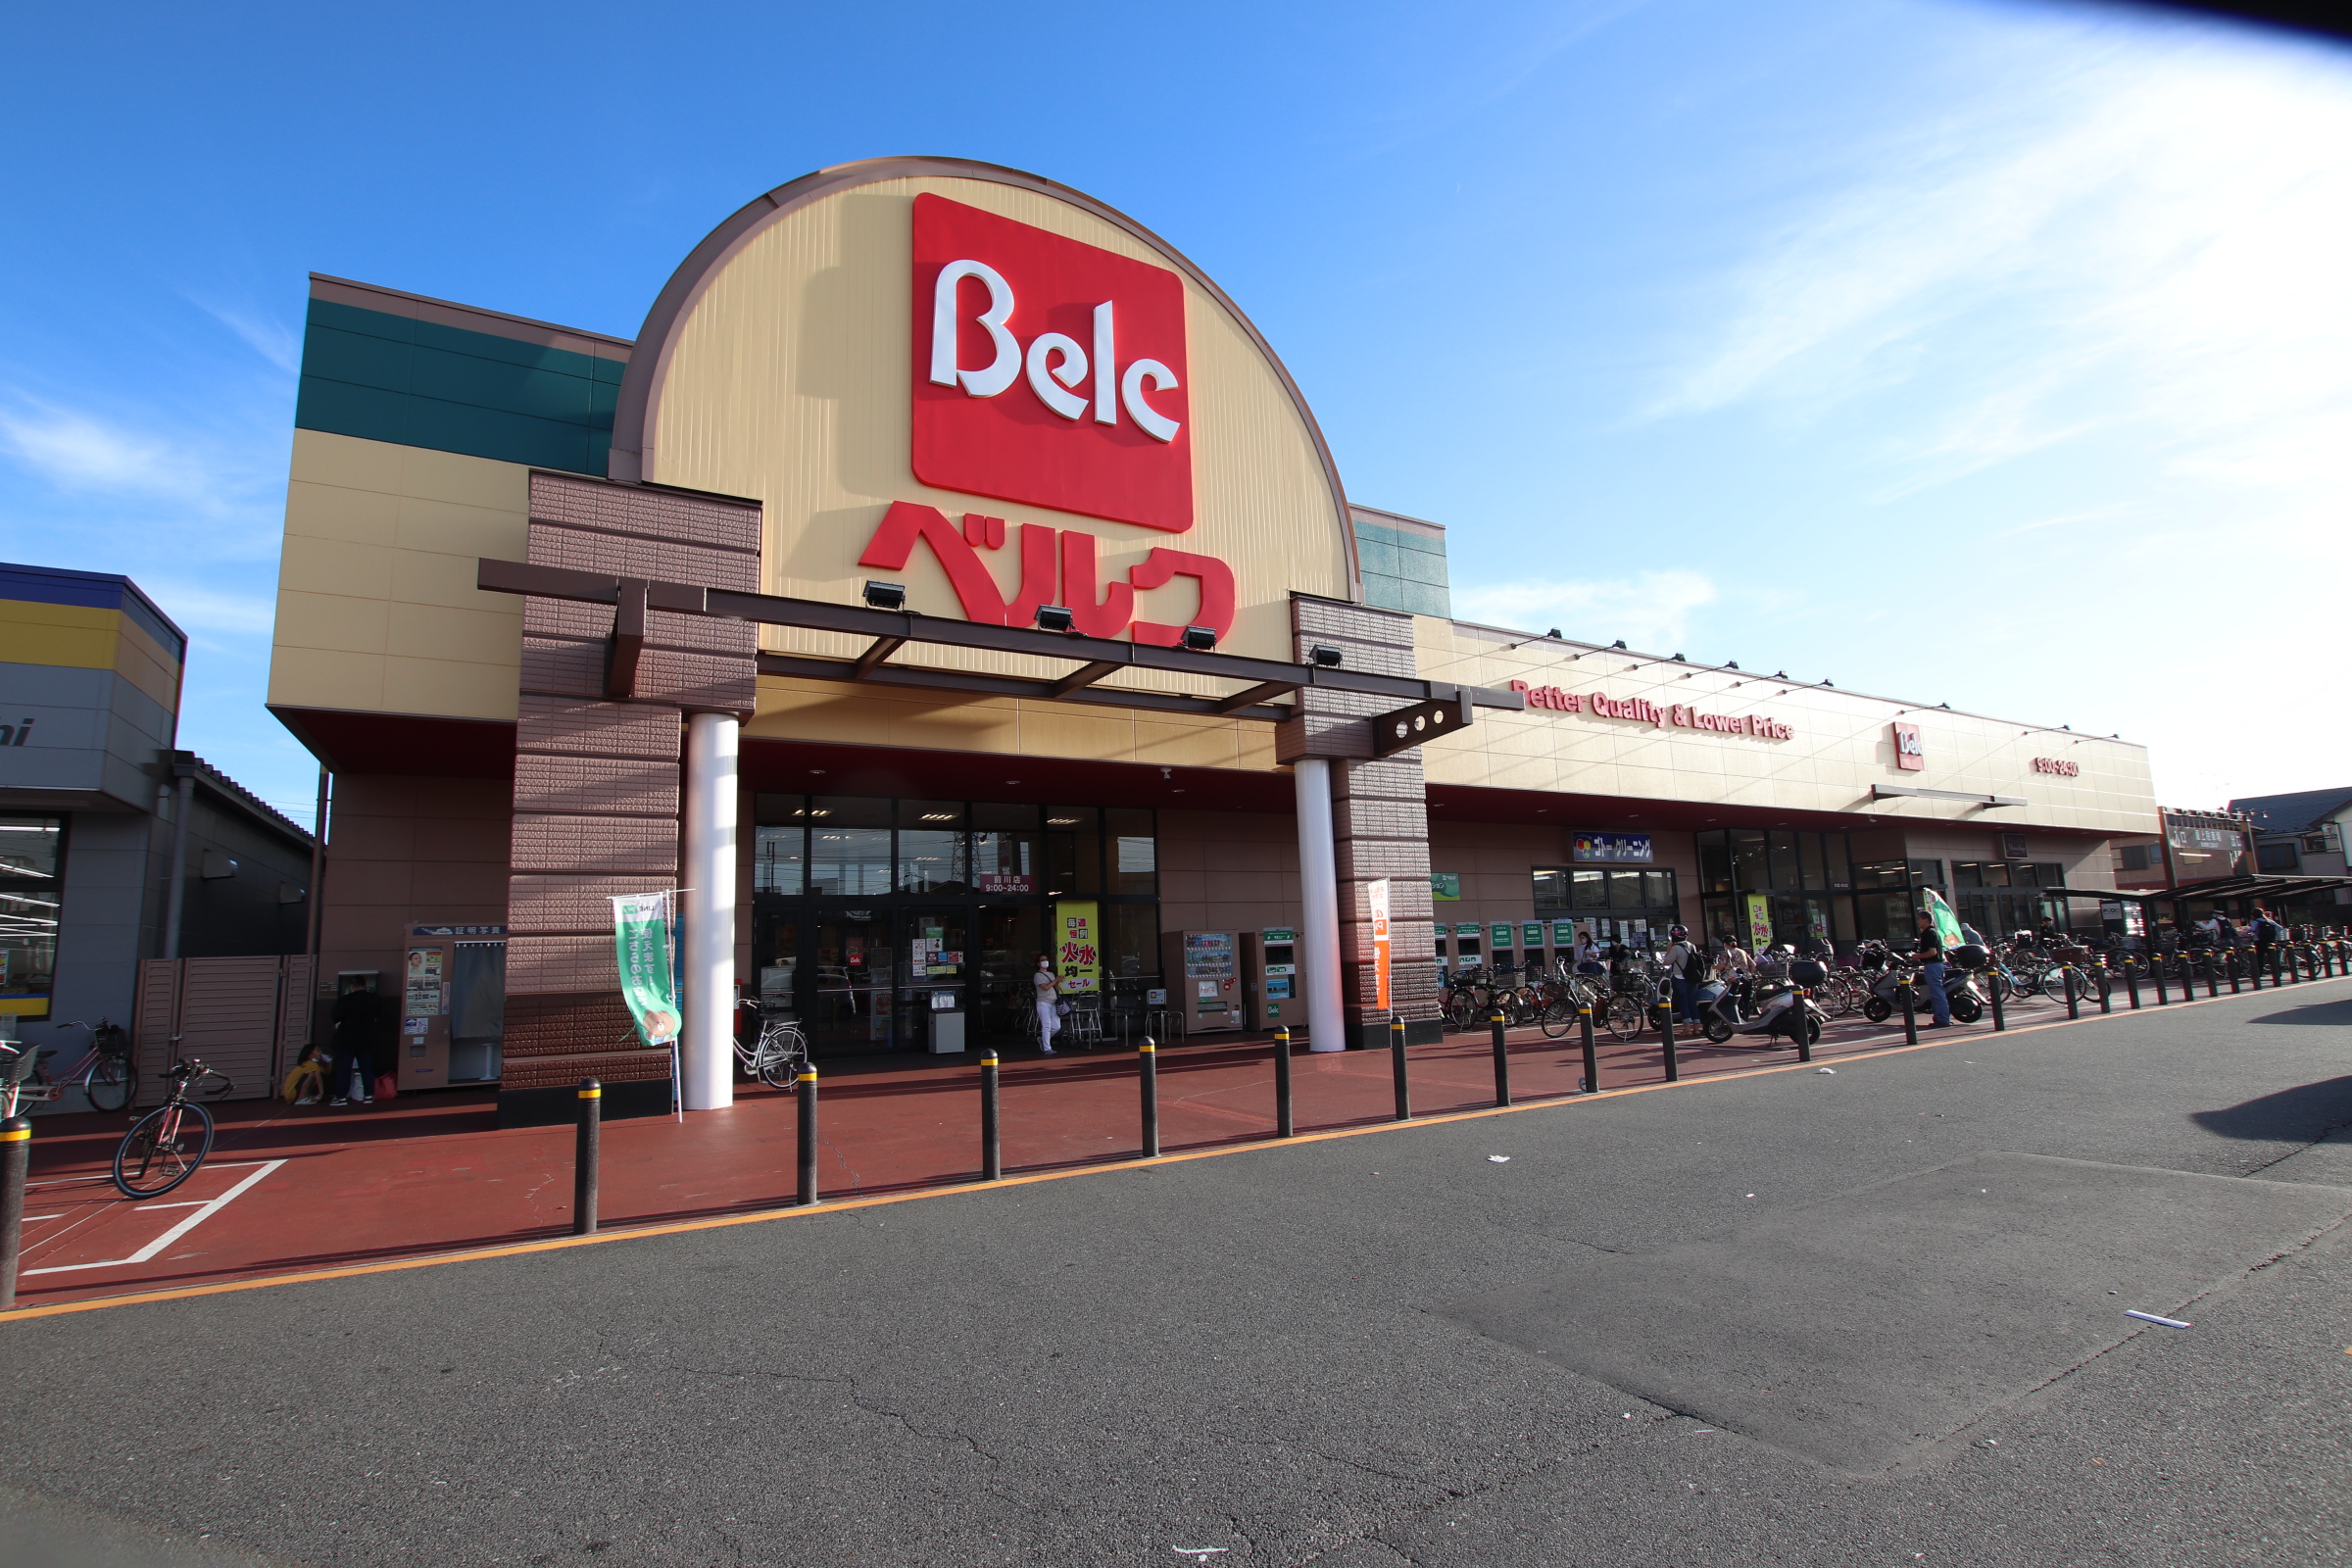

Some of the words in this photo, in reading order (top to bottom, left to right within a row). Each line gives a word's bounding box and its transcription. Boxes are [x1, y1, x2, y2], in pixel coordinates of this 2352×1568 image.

[929, 258, 1181, 444] Belc
[858, 500, 1235, 652] ベルク
[1510, 679, 1588, 713] Better
[1592, 691, 1667, 728] Quality
[1673, 703, 1689, 727] &
[1691, 706, 1748, 735] Lower
[1750, 713, 1795, 741] Price
[1898, 731, 1923, 756] Belc
[994, 875, 1021, 884] 前川店
[1067, 917, 1087, 928] 毎週
[455, 926, 501, 935] 証明写真
[1069, 928, 1088, 939] 恒例
[1060, 941, 1097, 965] 火水
[1064, 965, 1093, 978] 均一
[1068, 980, 1091, 989] セール
